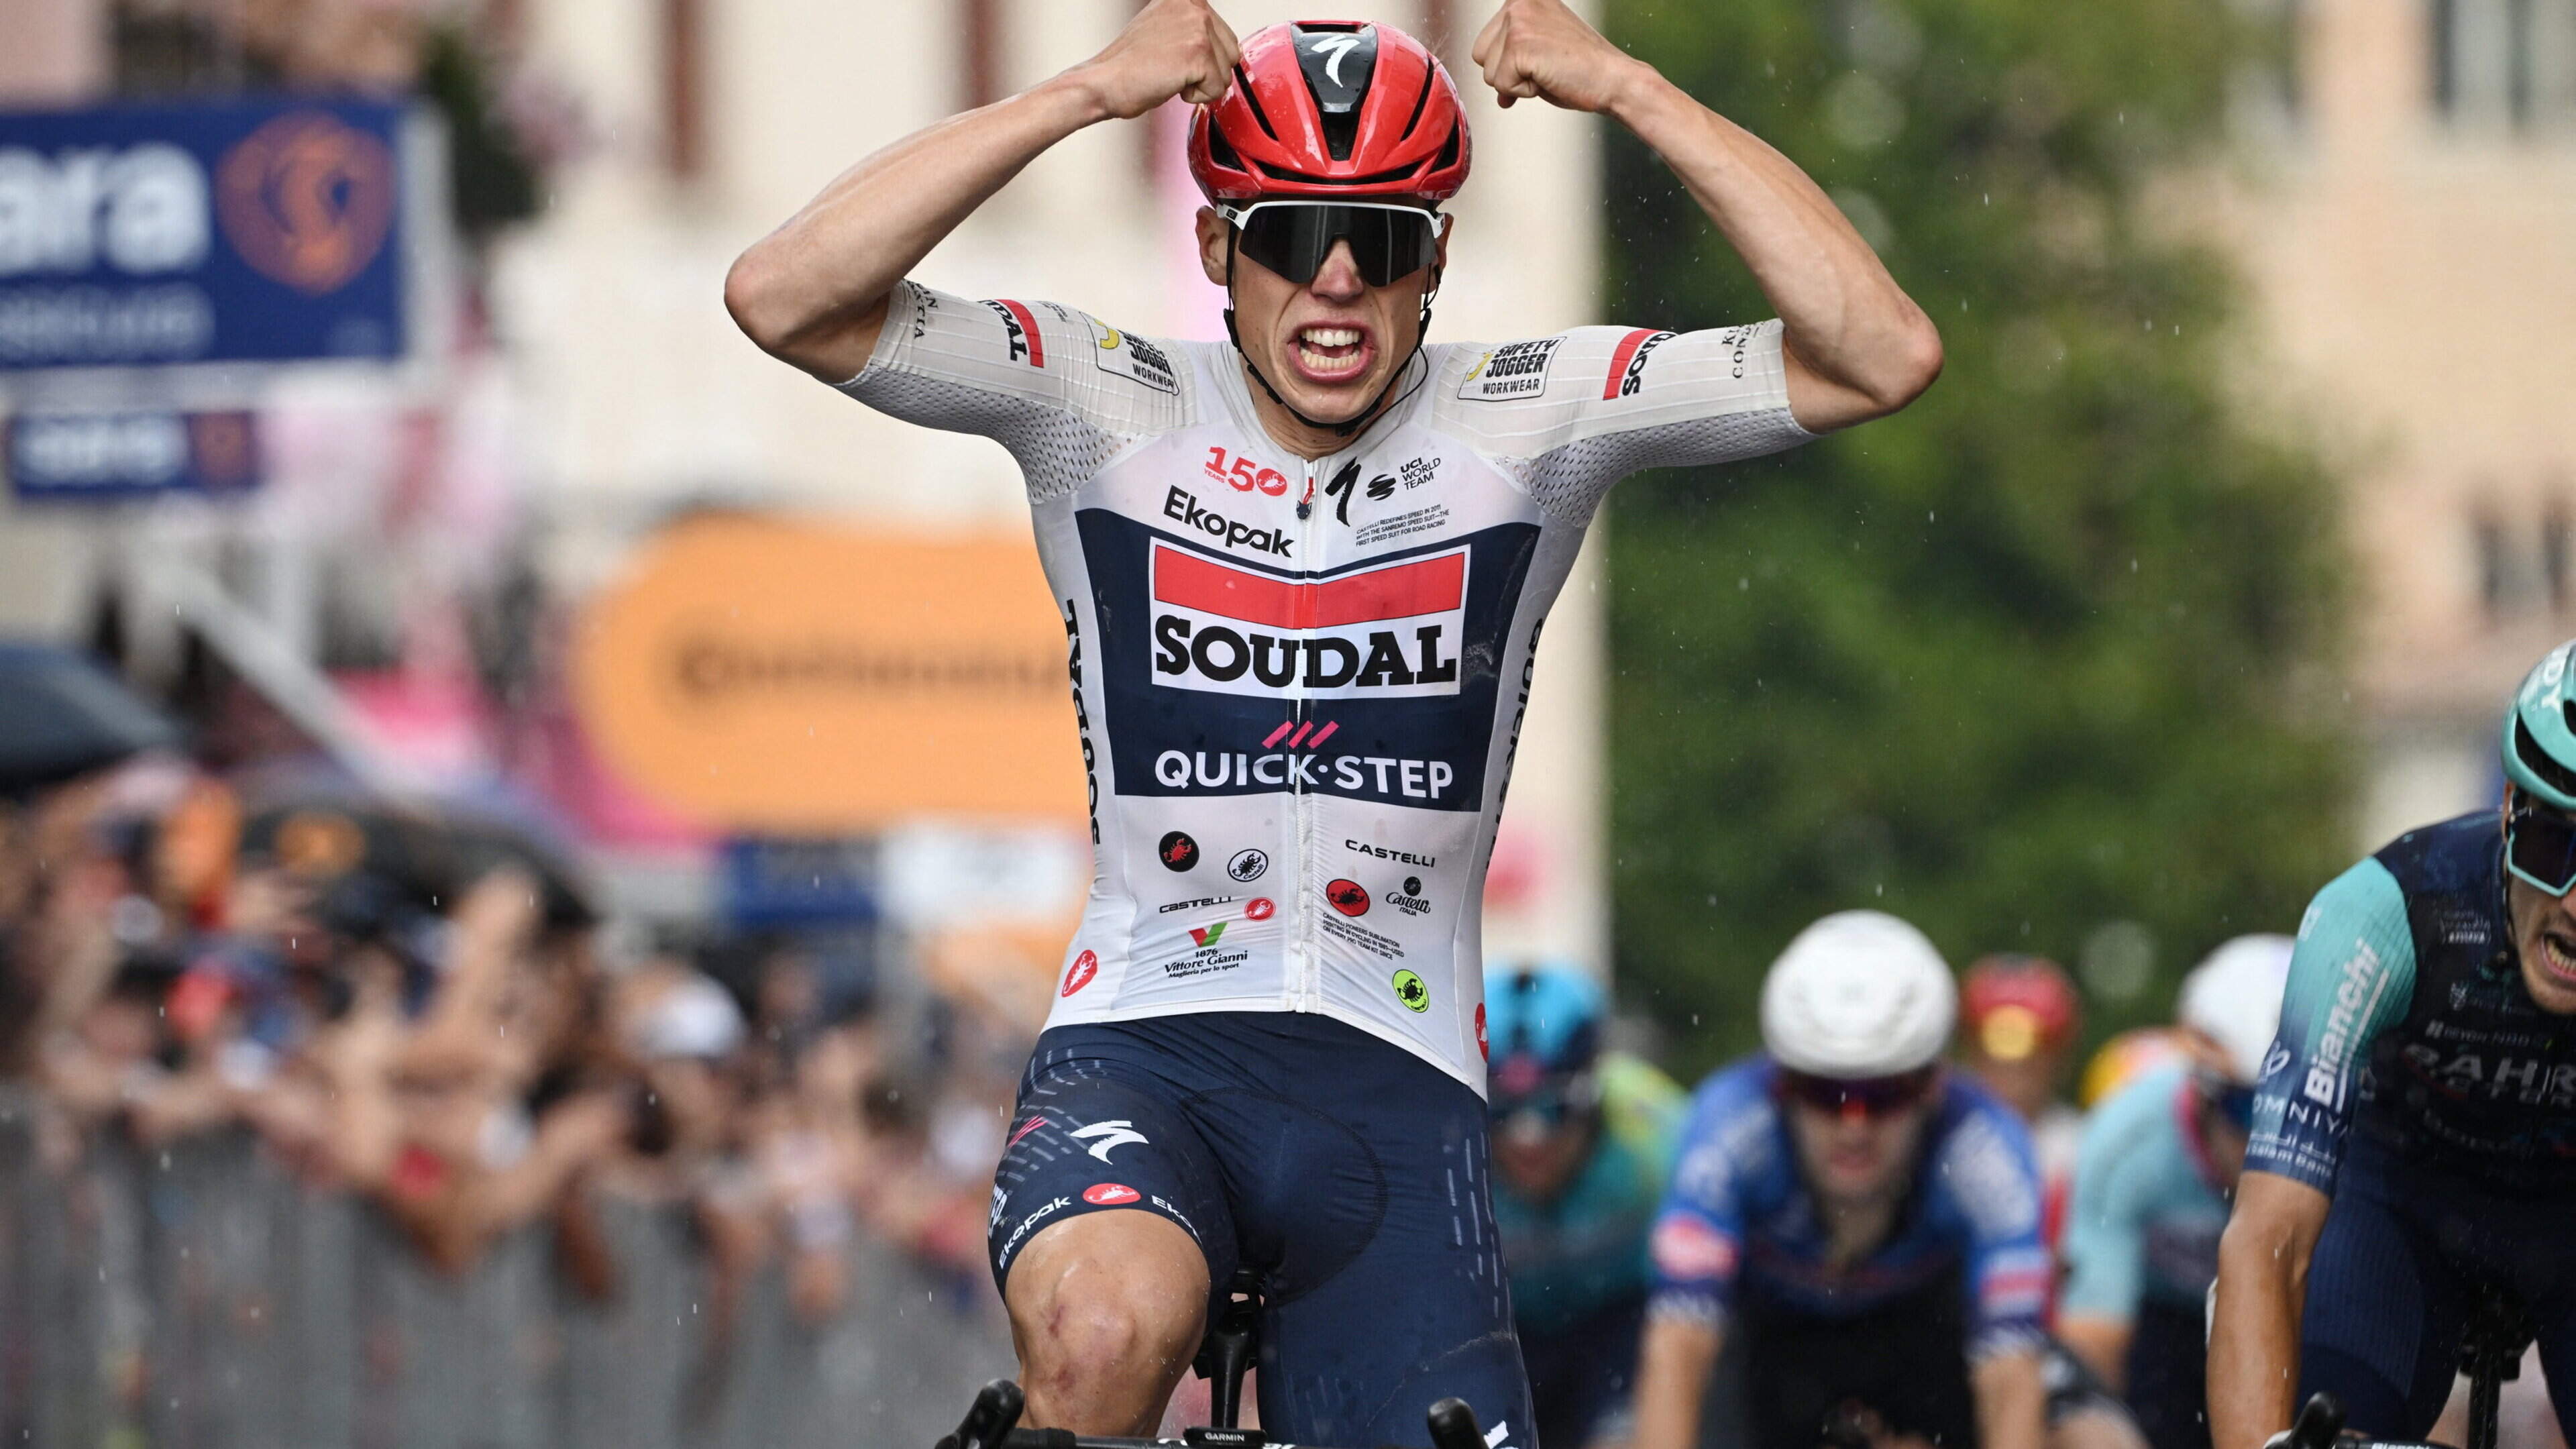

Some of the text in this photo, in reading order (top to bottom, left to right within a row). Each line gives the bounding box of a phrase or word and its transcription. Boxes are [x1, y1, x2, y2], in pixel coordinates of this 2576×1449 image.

[1494, 339, 1560, 358] SAFETY
[1486, 353, 1548, 378] JOGGER
[1483, 378, 1540, 394] WORKWEAR
[1203, 468, 1225, 484] YEARS
[1400, 457, 1422, 473] UCI
[1402, 458, 1441, 482] WORLD
[1404, 471, 1434, 490] TEAM
[1163, 484, 1295, 558] Ekopak
[1380, 514, 1407, 526] REDEFINES
[1407, 508, 1424, 519] SPEED
[1355, 519, 1446, 547] FIRST SPEED SUIT FOR ROAD RACING
[1356, 532, 1370, 541] WITH
[1371, 527, 1381, 535] THE
[1407, 517, 1424, 526] SPEED
[1155, 614, 1456, 689] SOUDAL
[1345, 839, 1436, 868] CASTELLI
[1243, 863, 1265, 880] Castelli
[1385, 892, 1431, 914] Castelli
[1399, 906, 1417, 916] ITALIA
[1322, 912, 1345, 926] CASTELLI
[1346, 922, 1368, 935] PIONEERS
[1323, 925, 1331, 933] ON
[1331, 928, 1346, 940] EVERY
[1357, 941, 1371, 951] TEAM
[1351, 932, 1372, 944] CYCLING
[1165, 950, 1248, 973] Vittore Gianni
[1195, 948, 1218, 958] 1876
[1169, 969, 1199, 979] Maglieria
[1200, 967, 1212, 975] per
[1222, 963, 1239, 971] sport
[2304, 936, 2381, 1108] Bianchi
[999, 1196, 1073, 1270] Ekopak
[1205, 1432, 1245, 1442] GARMIN
